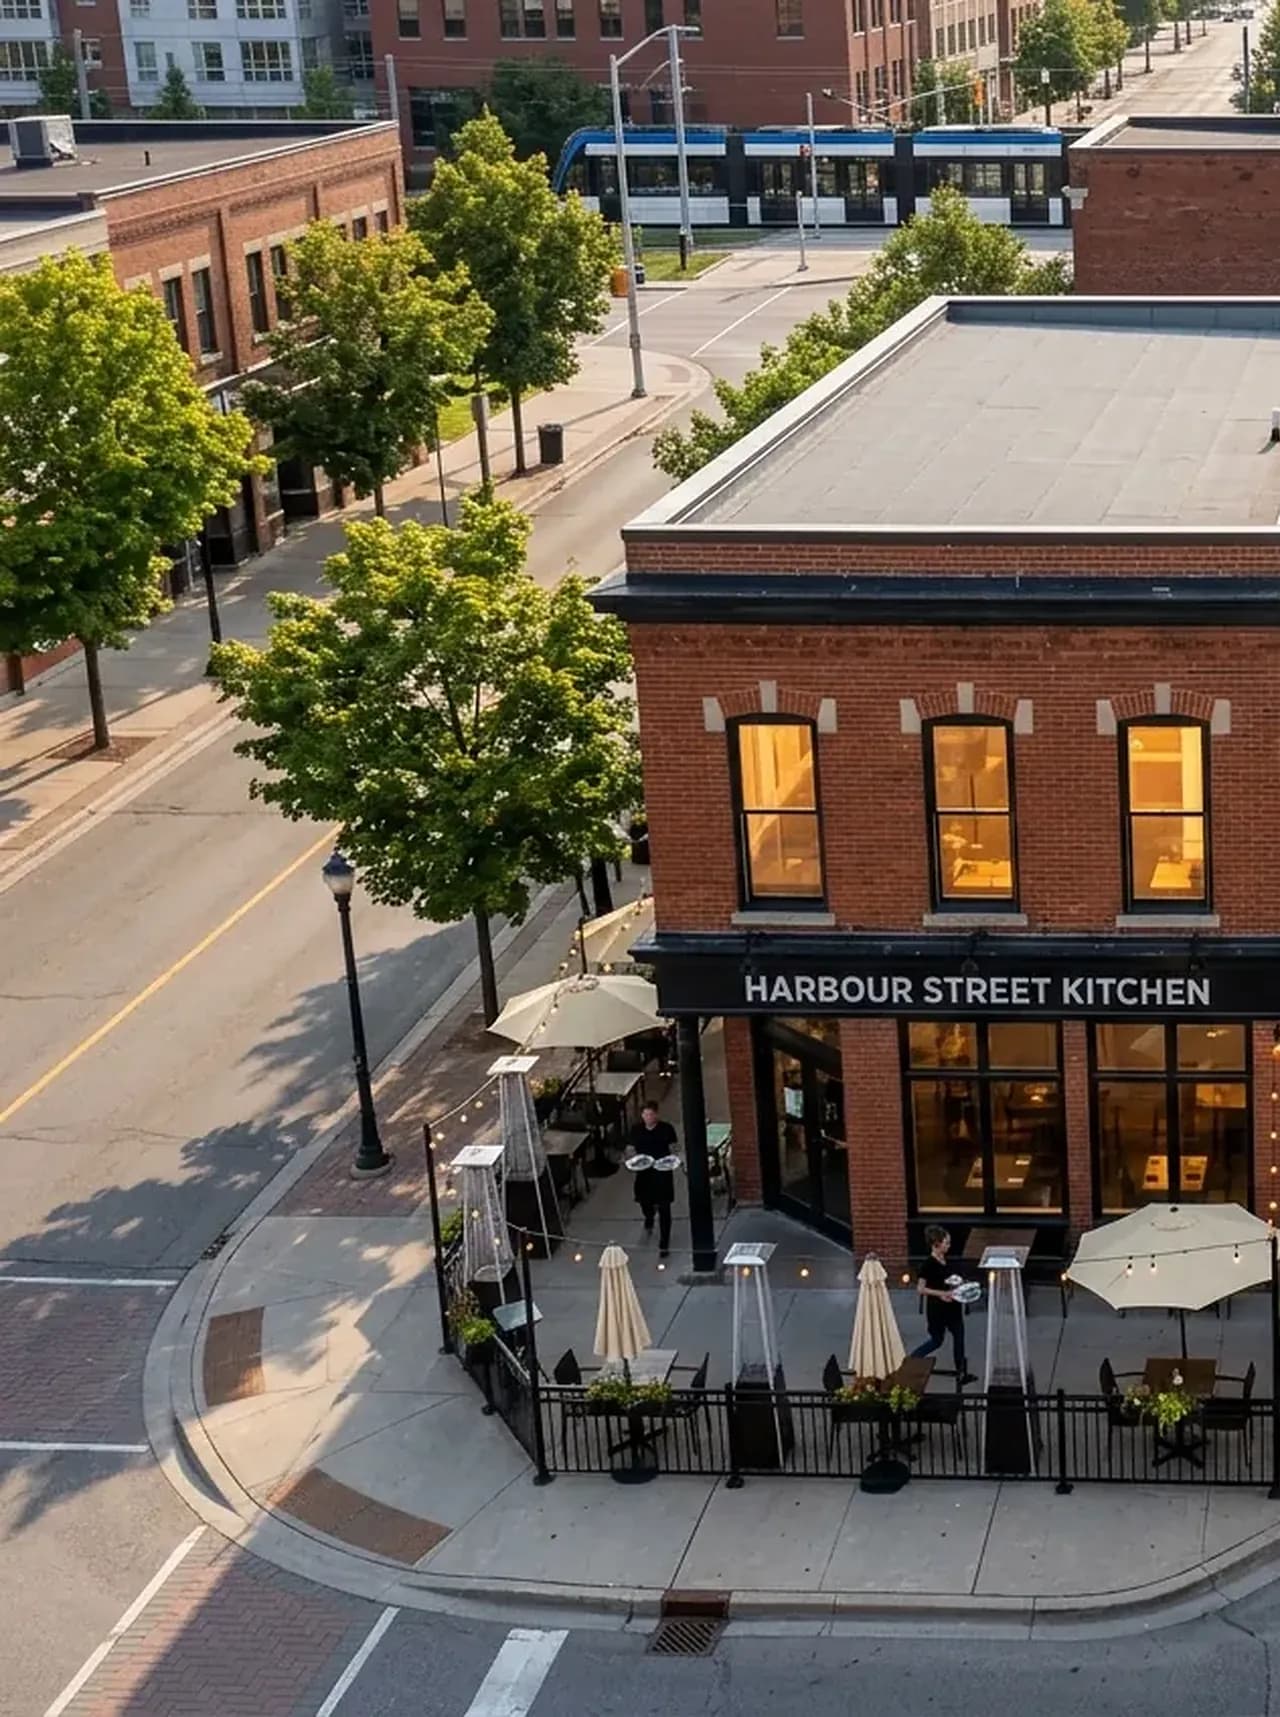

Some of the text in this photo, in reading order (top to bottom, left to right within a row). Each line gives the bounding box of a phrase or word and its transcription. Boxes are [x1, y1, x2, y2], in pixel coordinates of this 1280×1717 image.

[745, 975, 1210, 1005] HARBOUR STREET KITCHEN
